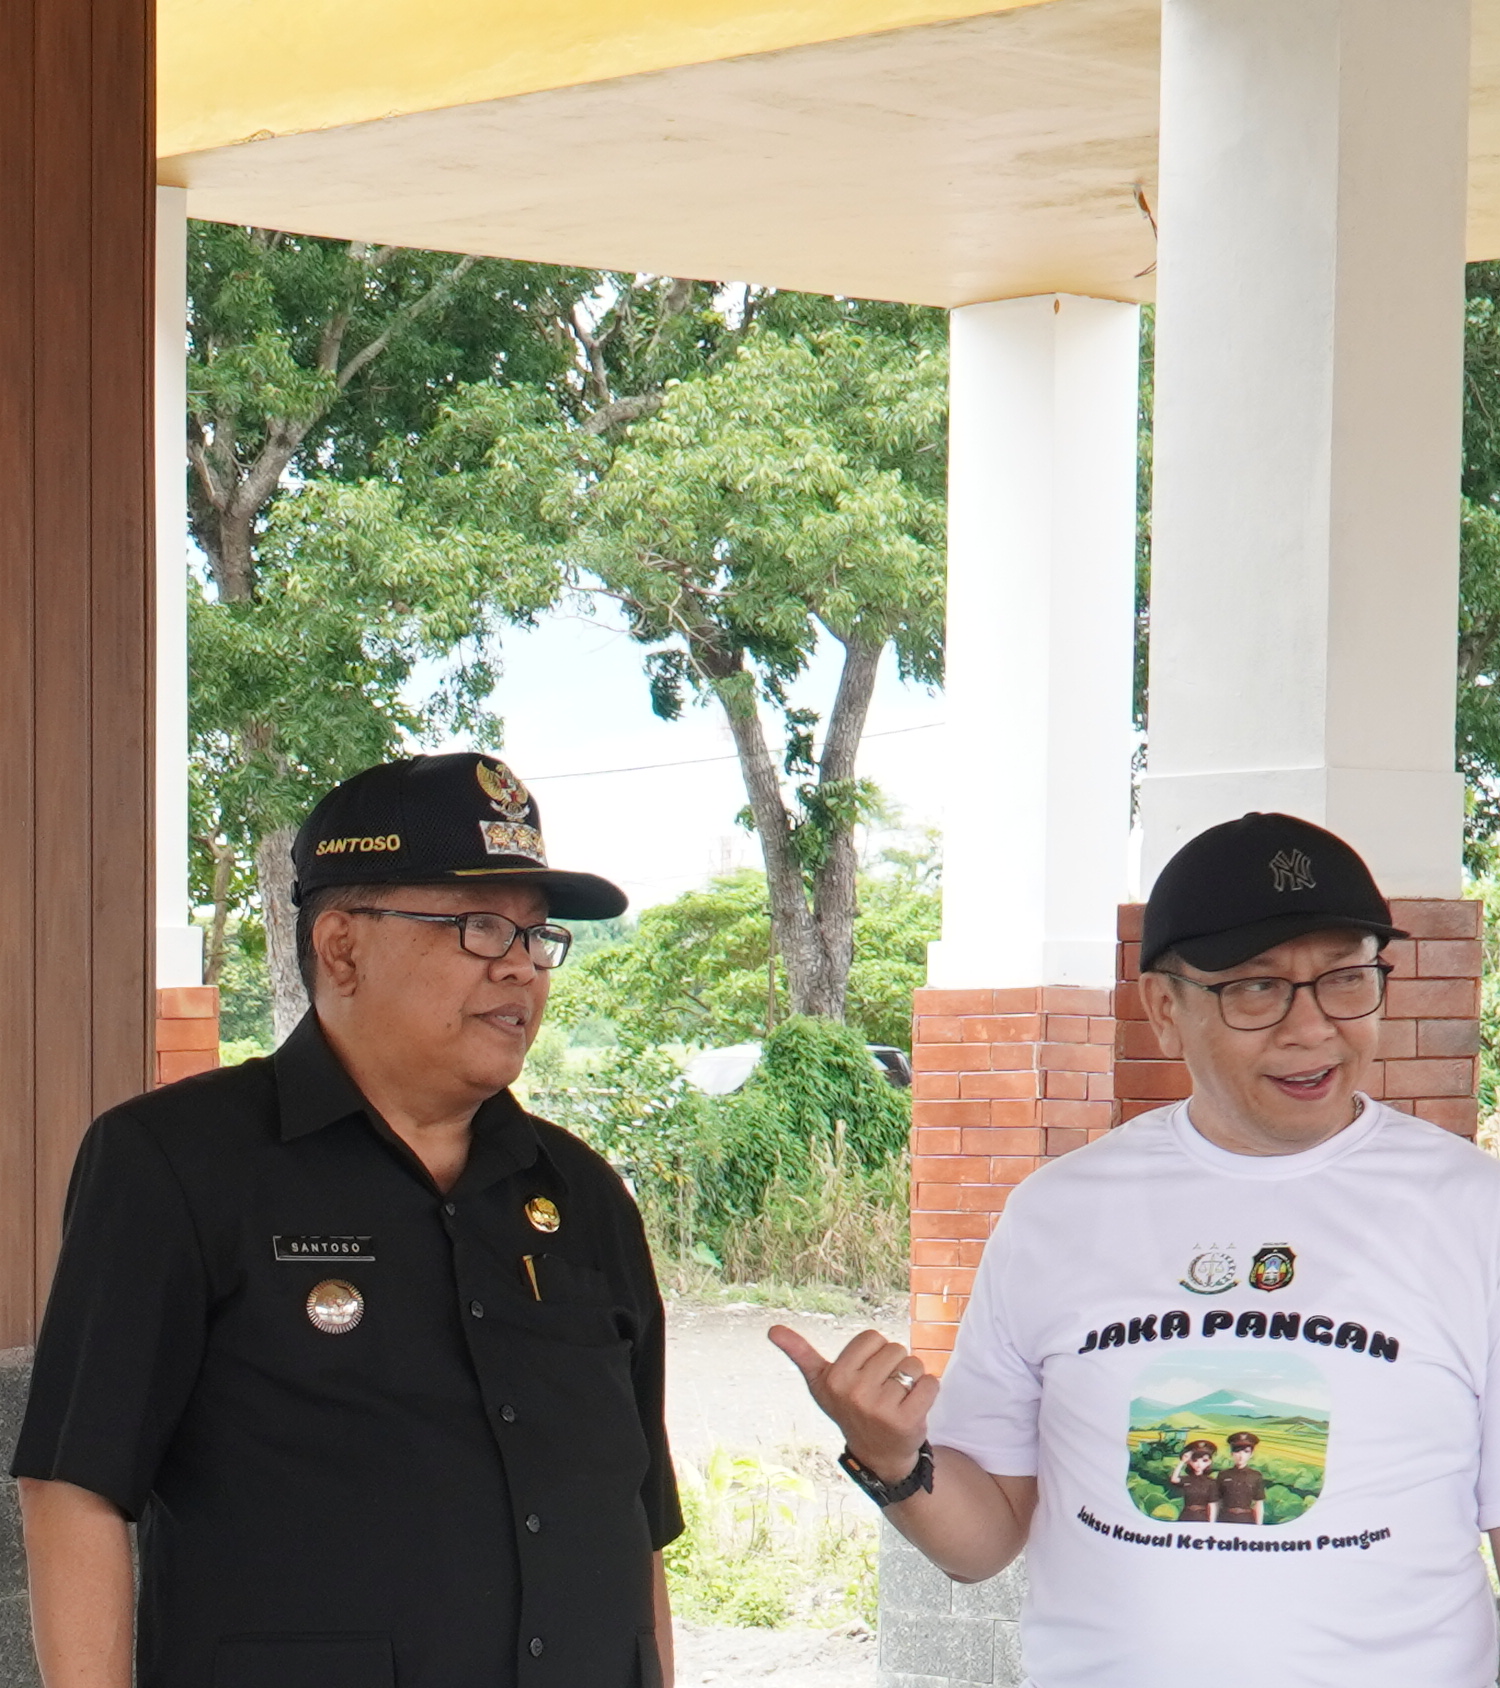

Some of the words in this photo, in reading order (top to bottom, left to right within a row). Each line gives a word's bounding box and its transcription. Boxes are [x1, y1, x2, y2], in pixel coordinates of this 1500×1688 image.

[315, 834, 401, 856] SANTOSO
[291, 1242, 361, 1254] SANTOSO
[1078, 1310, 1191, 1354] JAKA
[1201, 1310, 1400, 1363] PANGAN
[1077, 1505, 1111, 1535] Jaksa
[1112, 1524, 1173, 1548] Kawal
[1177, 1534, 1312, 1552] Ketahanan
[1316, 1527, 1391, 1550] Pangan
